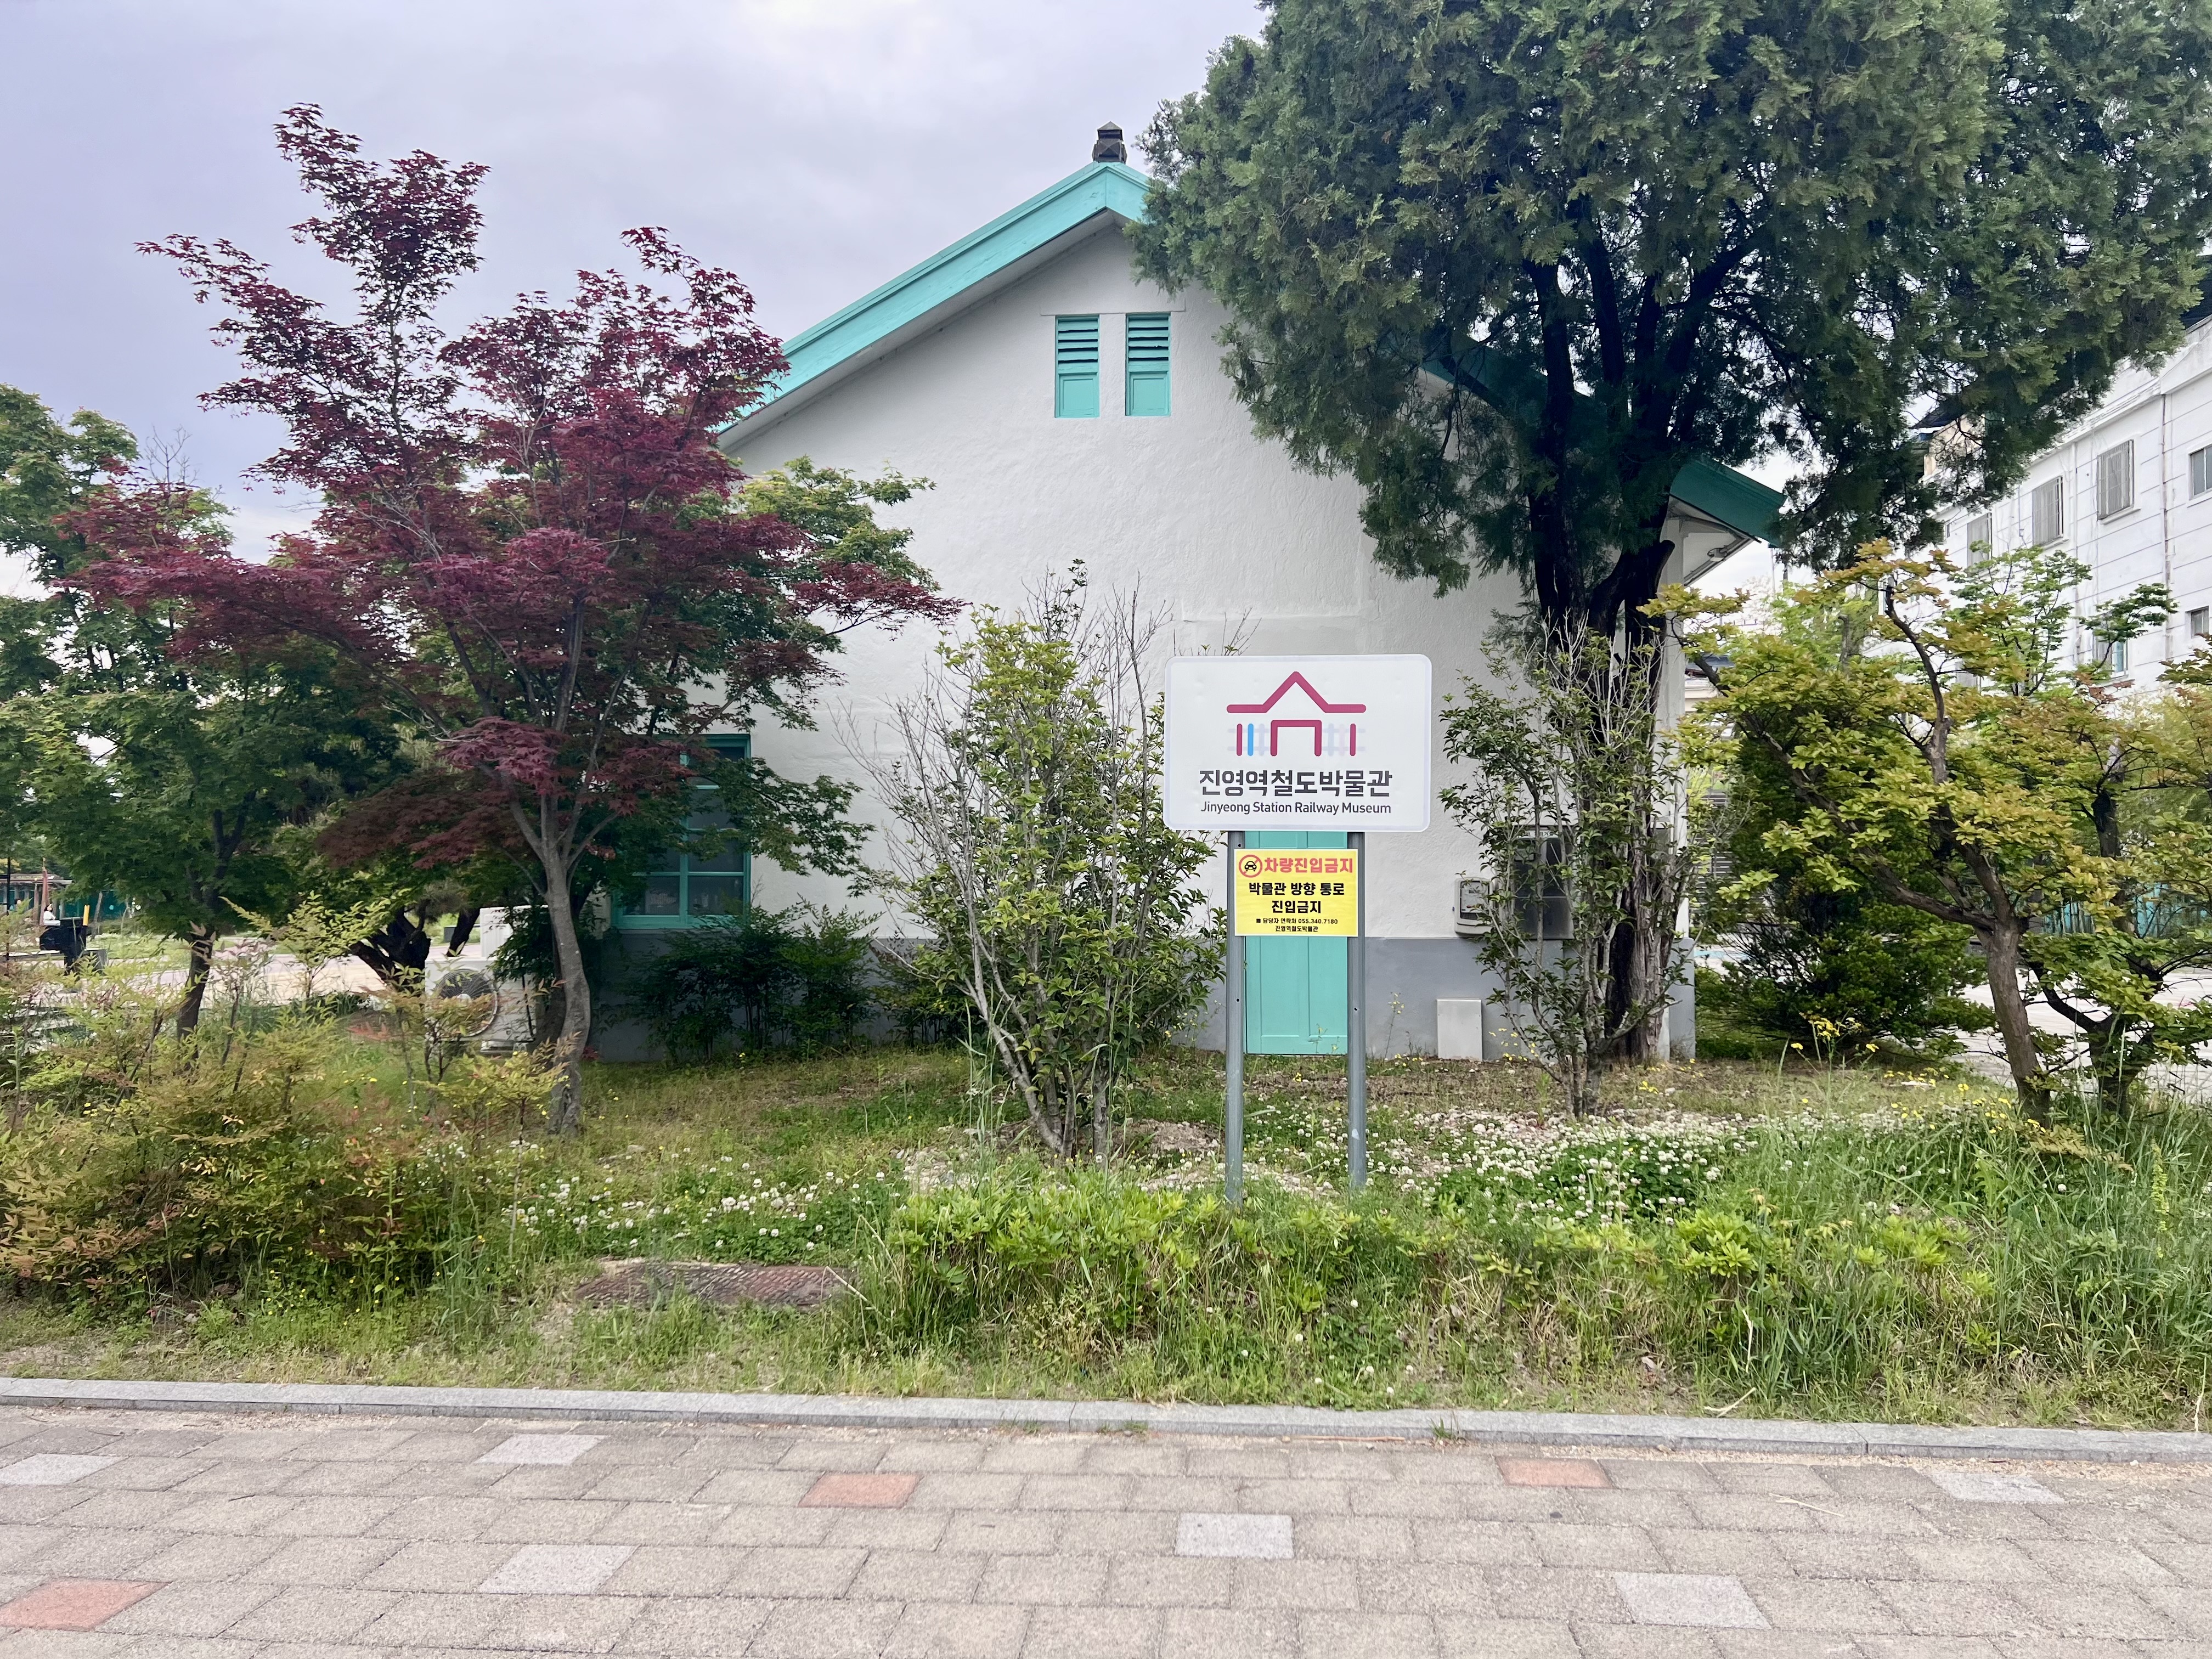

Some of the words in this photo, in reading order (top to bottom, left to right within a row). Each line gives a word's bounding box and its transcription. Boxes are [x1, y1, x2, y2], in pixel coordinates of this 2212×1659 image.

[1199, 769, 1393, 797] 진영역철도박물관
[1200, 801, 1250, 815] Jinyeong
[1252, 801, 1292, 814] Station
[1295, 801, 1339, 815] Railway
[1342, 802, 1391, 814] Museum
[1264, 857, 1353, 873] 차량진입금지
[1249, 882, 1286, 896] 박물관
[1290, 882, 1316, 896] 방향
[1319, 882, 1345, 896] 통로
[1272, 900, 1321, 913] 진입금지
